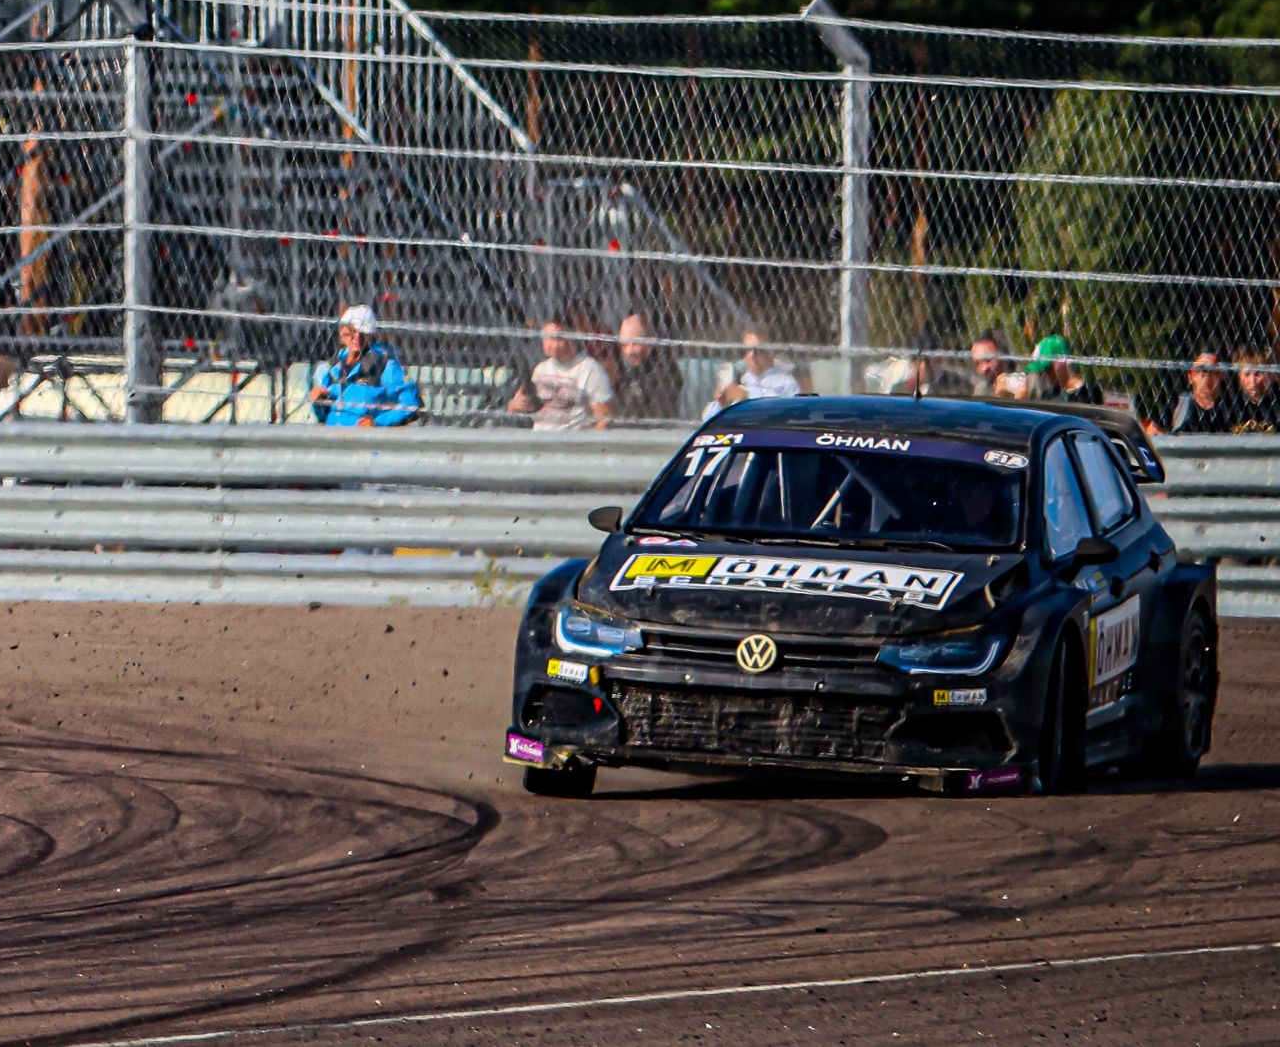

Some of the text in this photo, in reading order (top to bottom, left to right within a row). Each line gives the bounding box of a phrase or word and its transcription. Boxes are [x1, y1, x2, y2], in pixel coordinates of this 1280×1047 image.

[685, 446, 732, 477] 17
[815, 432, 912, 452] ÖHMAN
[986, 452, 1027, 468] FIA
[726, 558, 941, 591] ÖHMAN
